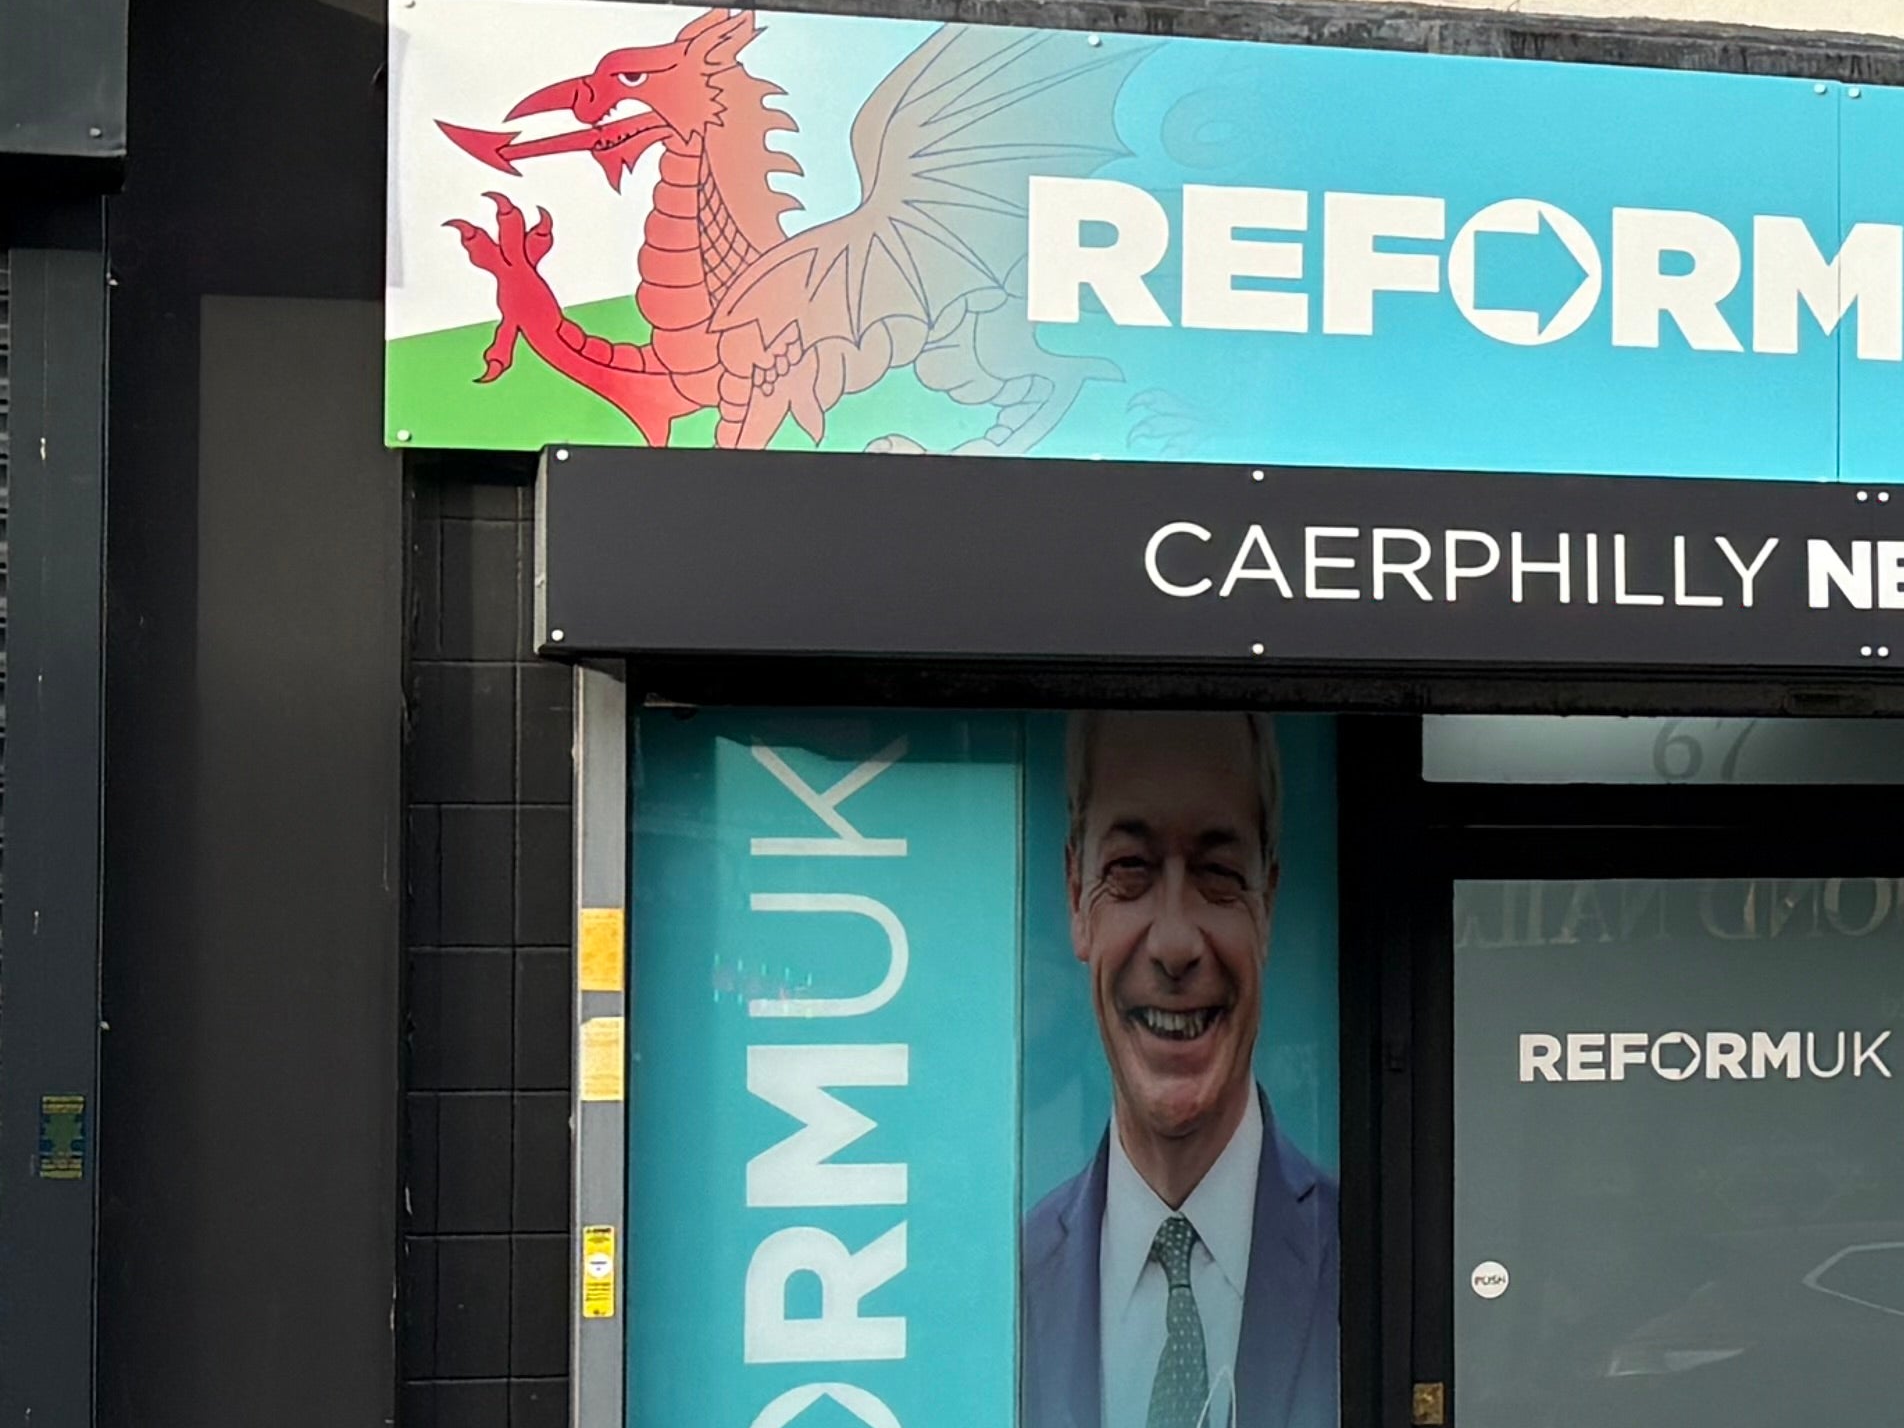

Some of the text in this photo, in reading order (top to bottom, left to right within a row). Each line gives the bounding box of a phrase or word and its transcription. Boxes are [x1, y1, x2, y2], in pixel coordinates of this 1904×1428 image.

[1144, 522, 1778, 609] CAERPHILLY
[1652, 718, 1760, 782] 67
[1518, 1029, 1892, 1083] REFORMUK
